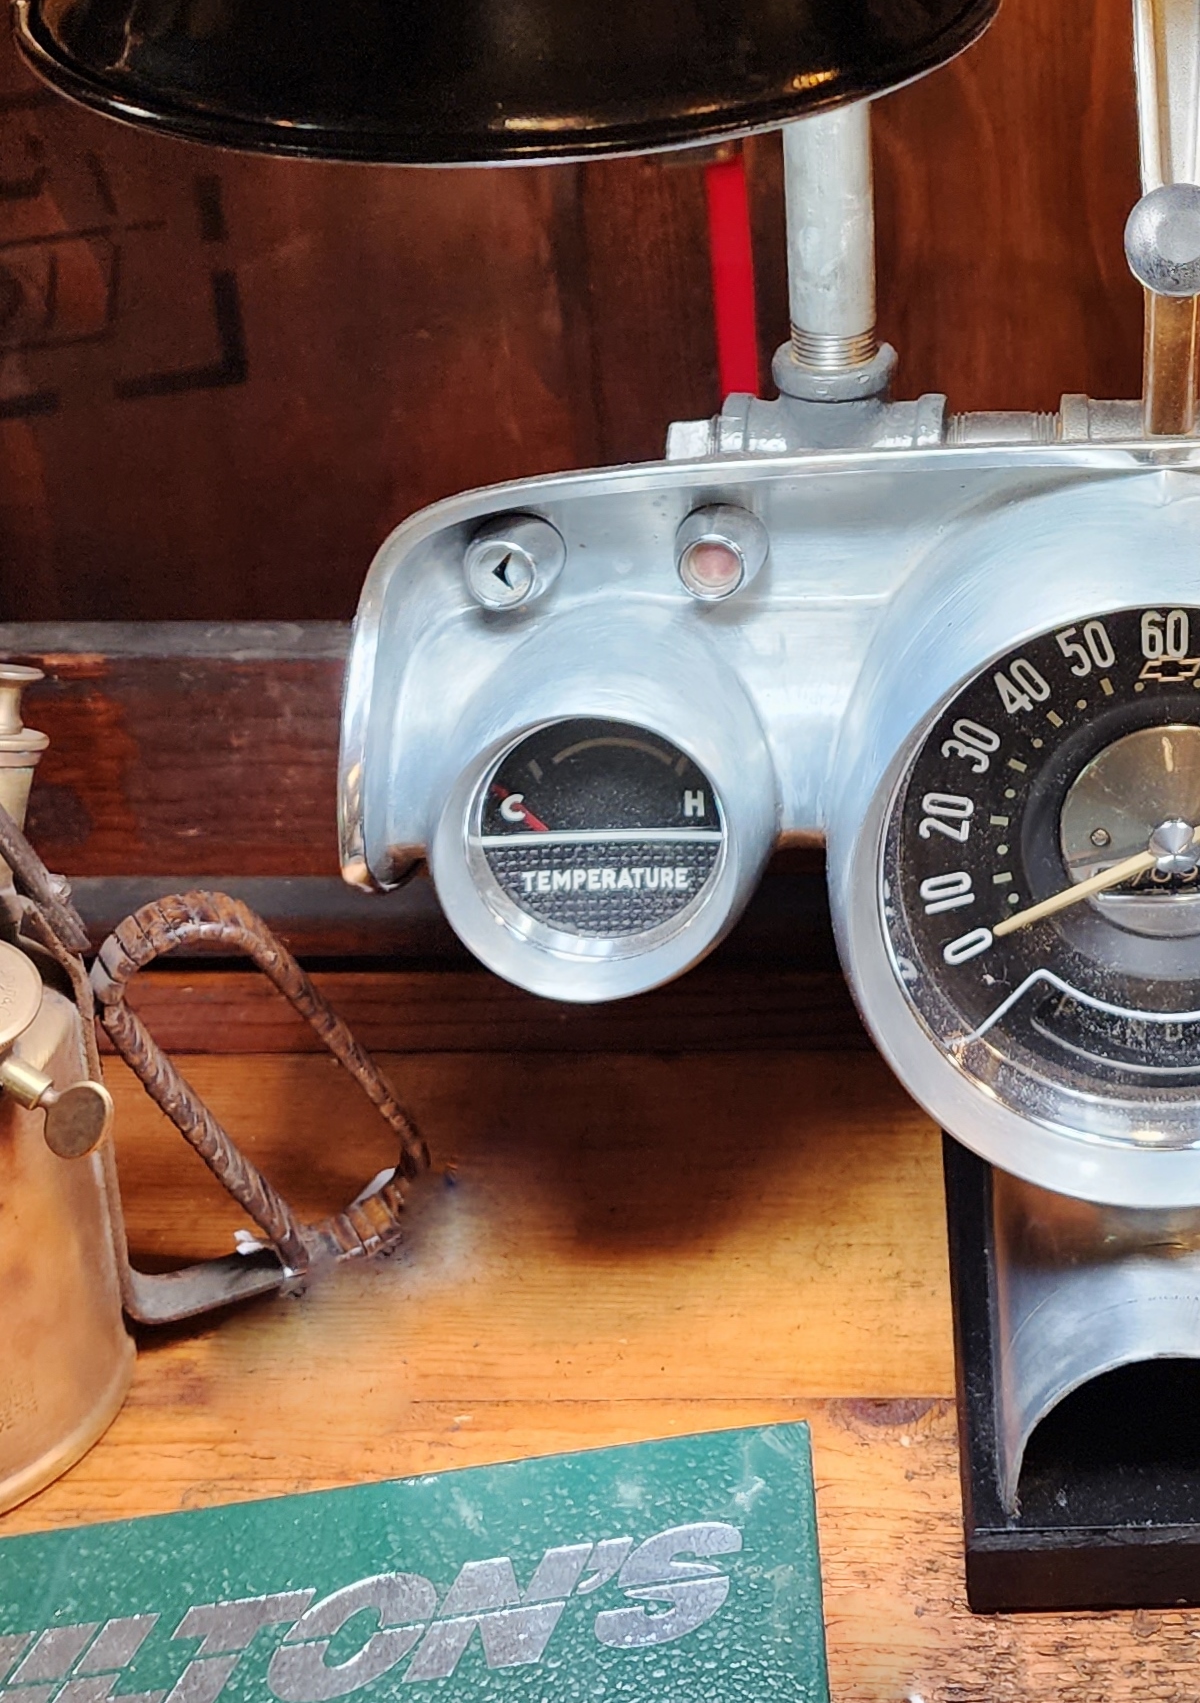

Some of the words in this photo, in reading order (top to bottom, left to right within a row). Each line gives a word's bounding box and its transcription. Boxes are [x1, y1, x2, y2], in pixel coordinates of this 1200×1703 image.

[1055, 620, 1115, 677] 50
[1141, 610, 1189, 659] 60
[993, 658, 1051, 714] 40
[941, 718, 1000, 774] 30
[500, 793, 526, 822] C
[683, 789, 705, 817] H
[919, 792, 974, 842] 20
[520, 866, 690, 893] TEMPERATURE
[920, 871, 975, 914] 10
[943, 927, 993, 966] 0
[0, 1521, 743, 1703] ILTON'S
